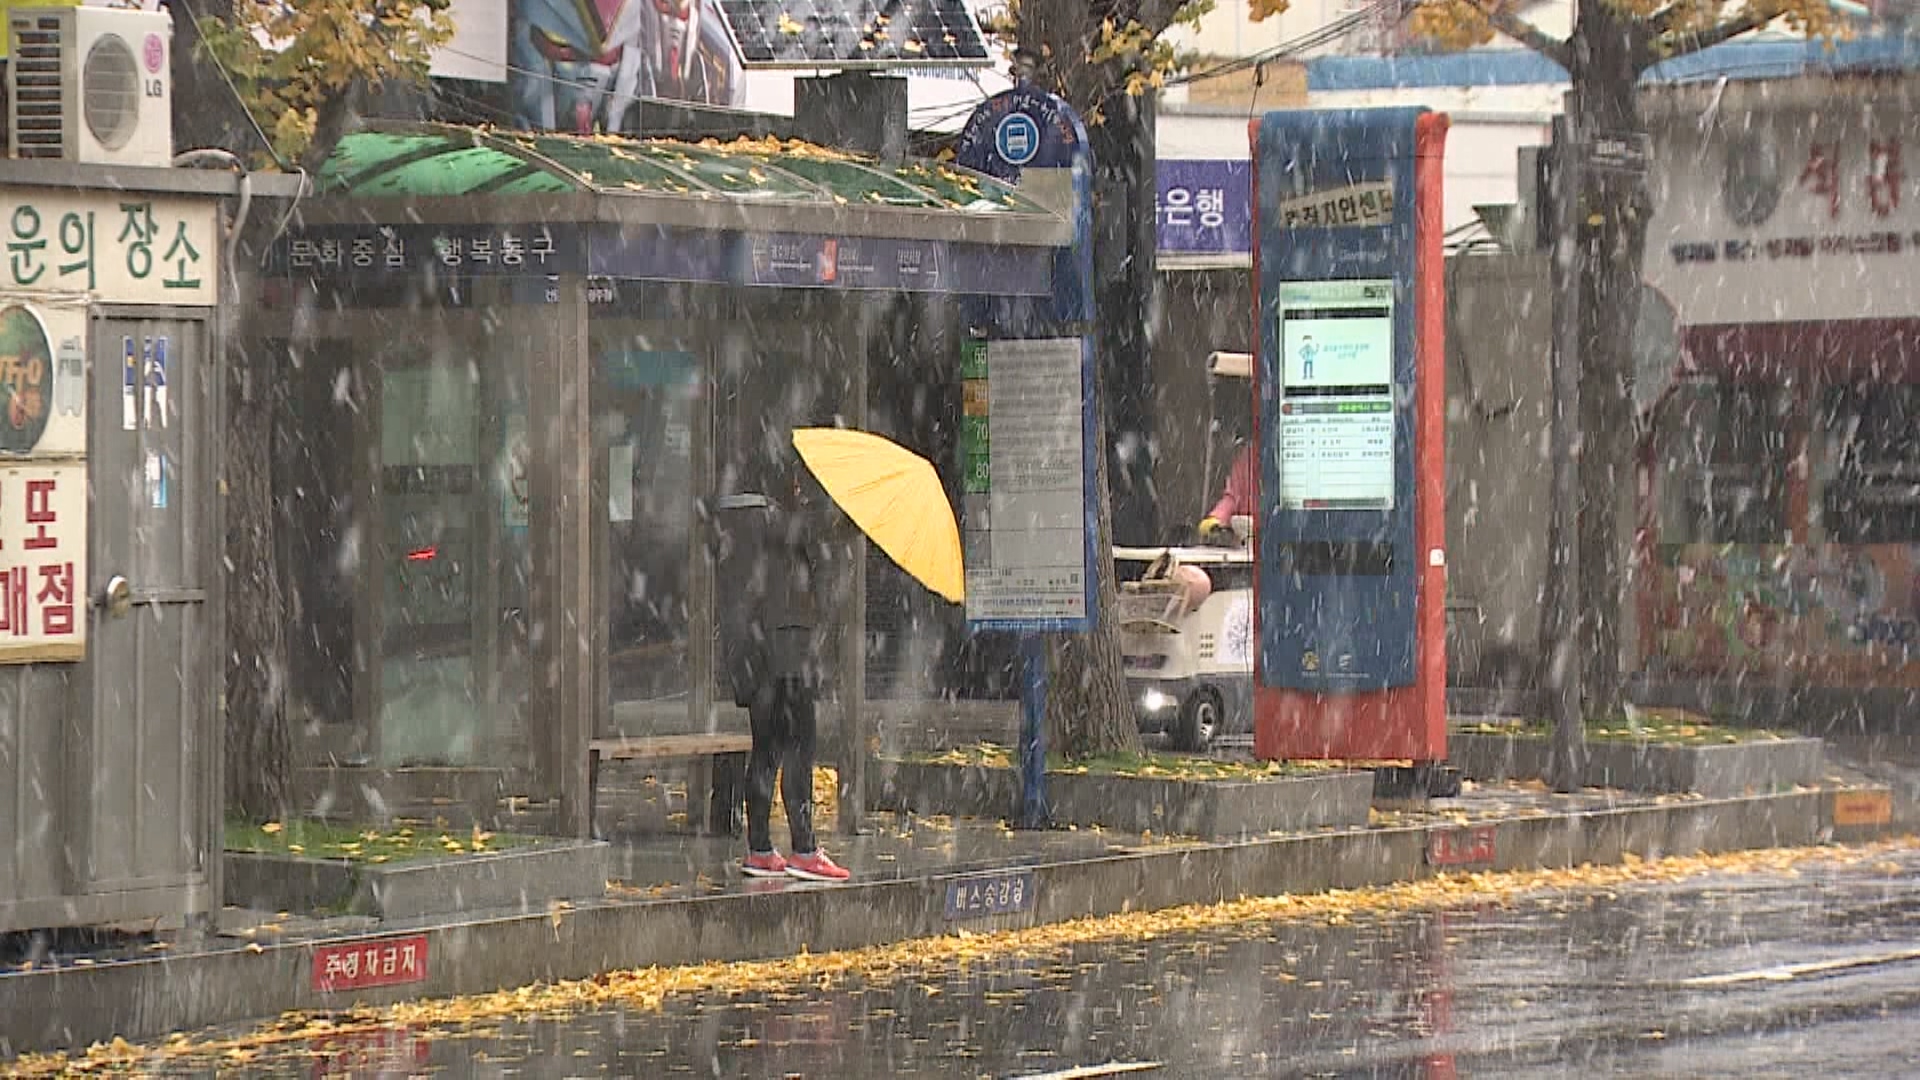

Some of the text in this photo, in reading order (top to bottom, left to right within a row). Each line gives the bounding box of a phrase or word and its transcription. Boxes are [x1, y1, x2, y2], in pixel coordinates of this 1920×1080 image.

[145, 79, 162, 97] LG
[1155, 188, 1223, 228] 은행
[7, 202, 200, 289] 운의 장소
[975, 463, 988, 478] 80
[0, 480, 57, 549] 또
[325, 945, 416, 981] 주정차금지
